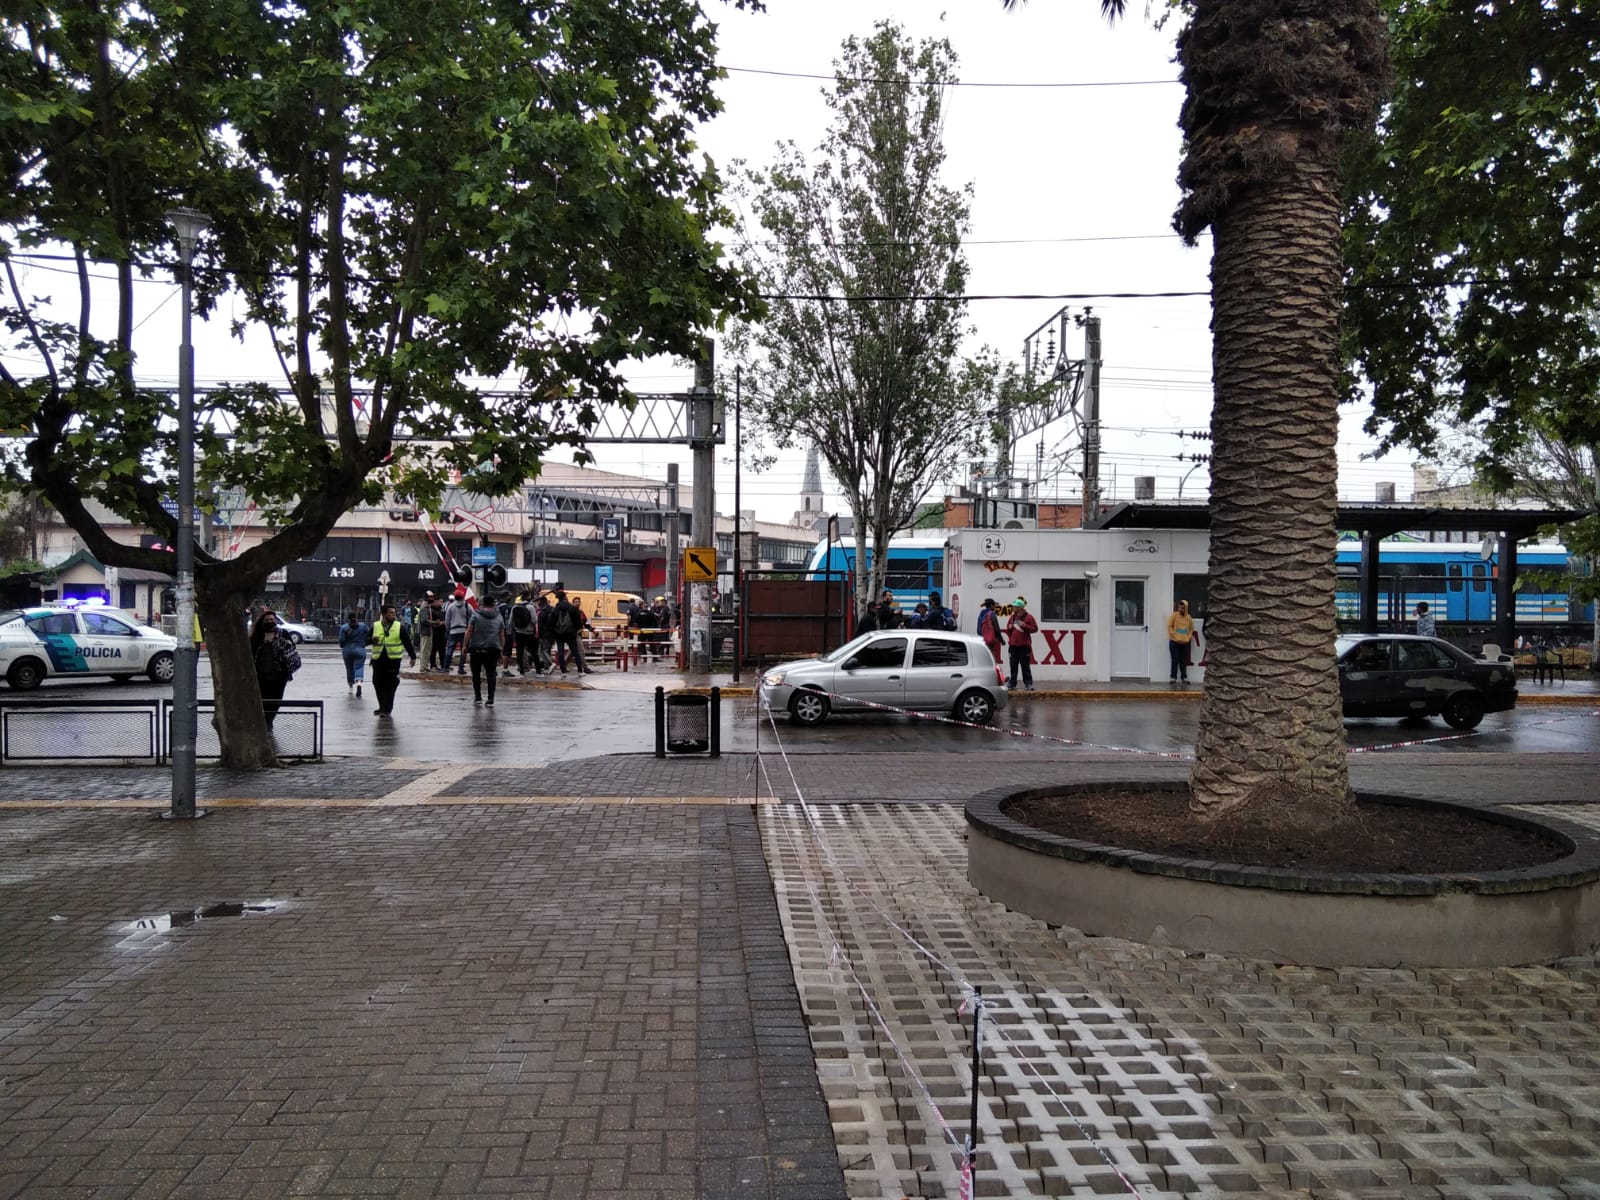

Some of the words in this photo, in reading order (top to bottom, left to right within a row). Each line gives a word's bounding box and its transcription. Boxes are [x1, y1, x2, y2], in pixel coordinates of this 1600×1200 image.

[985, 538, 1001, 549] 24
[983, 560, 1019, 573] TAXI
[329, 567, 355, 578] A-53
[418, 569, 436, 580] A-53
[75, 646, 122, 658] POLICIA
[992, 629, 1087, 666] TXI
